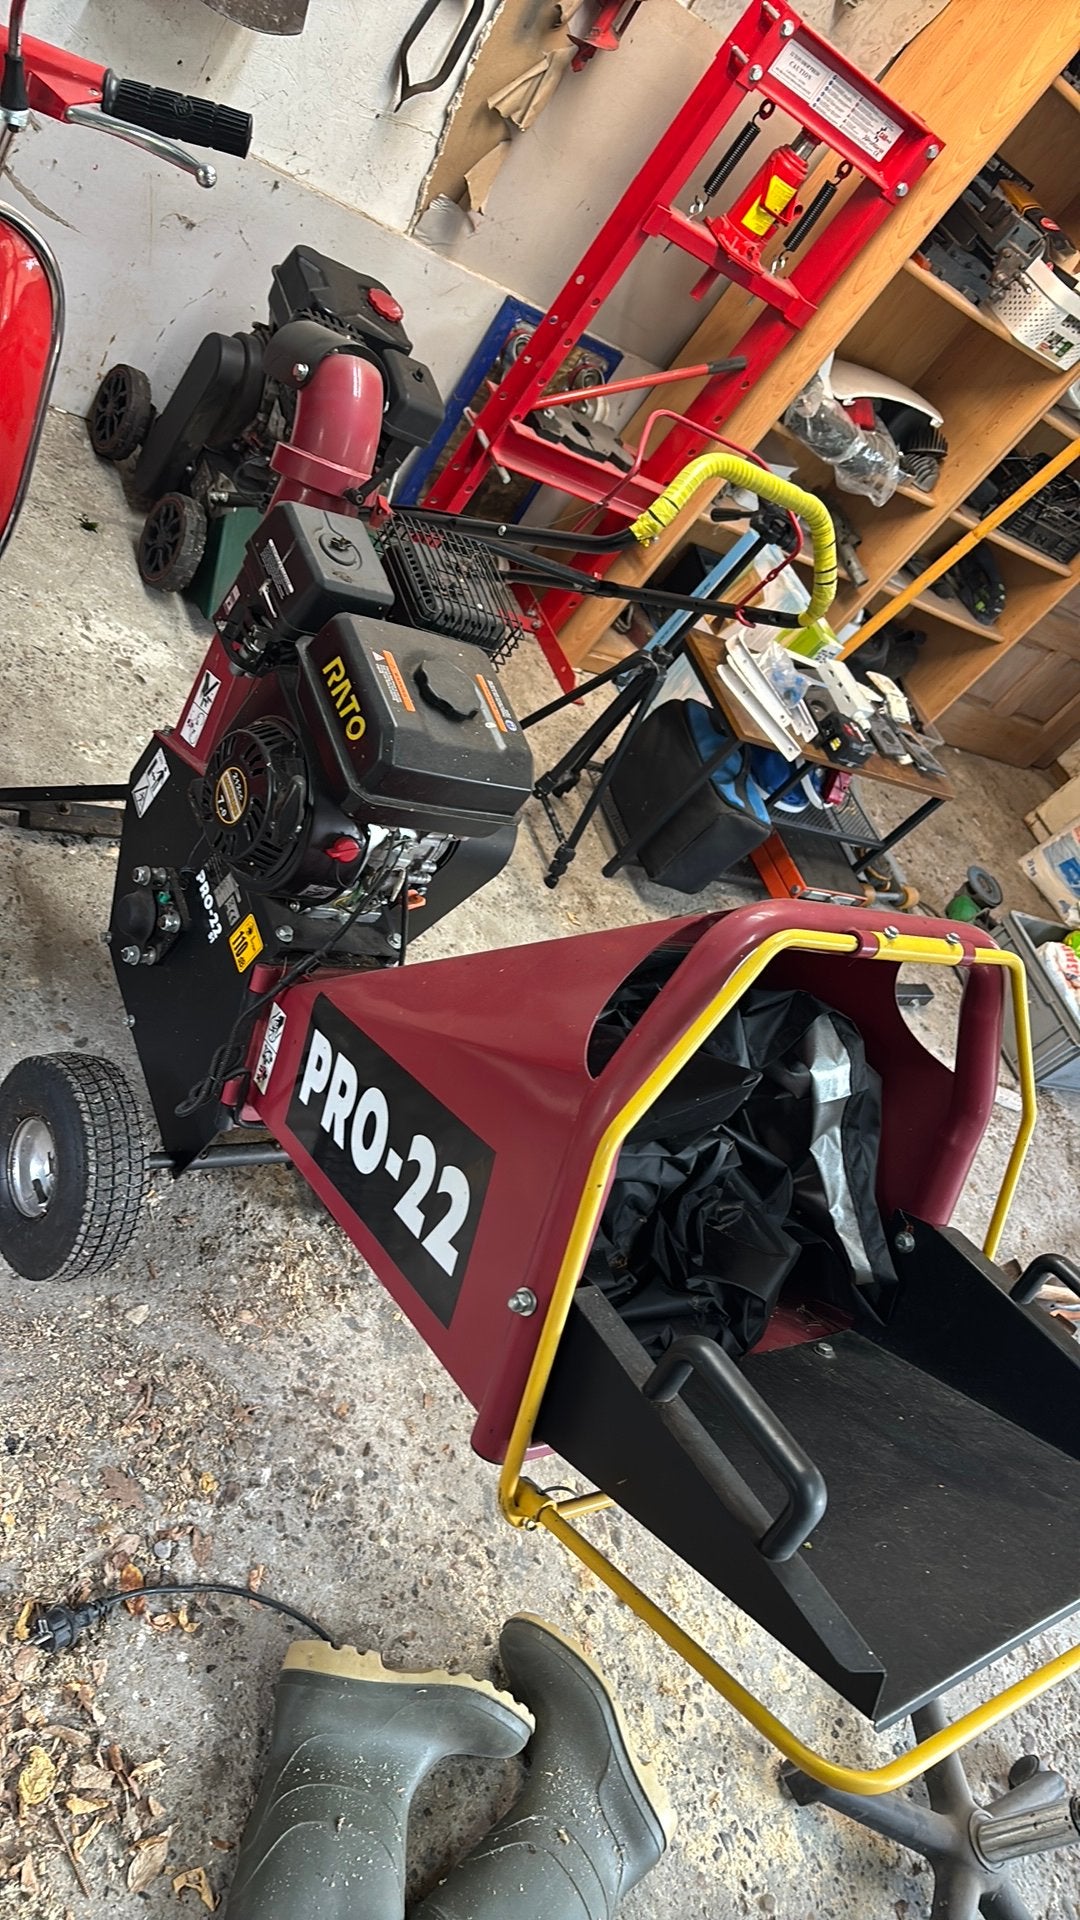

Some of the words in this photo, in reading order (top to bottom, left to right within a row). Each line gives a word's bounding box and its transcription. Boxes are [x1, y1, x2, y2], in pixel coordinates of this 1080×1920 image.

[789, 60, 812, 80] CAUTION
[322, 656, 366, 741] RATO
[217, 794, 227, 817] 7.0
[195, 869, 222, 939] PRO-22
[231, 930, 249, 958] 110
[298, 1028, 470, 1278] PRO-22
